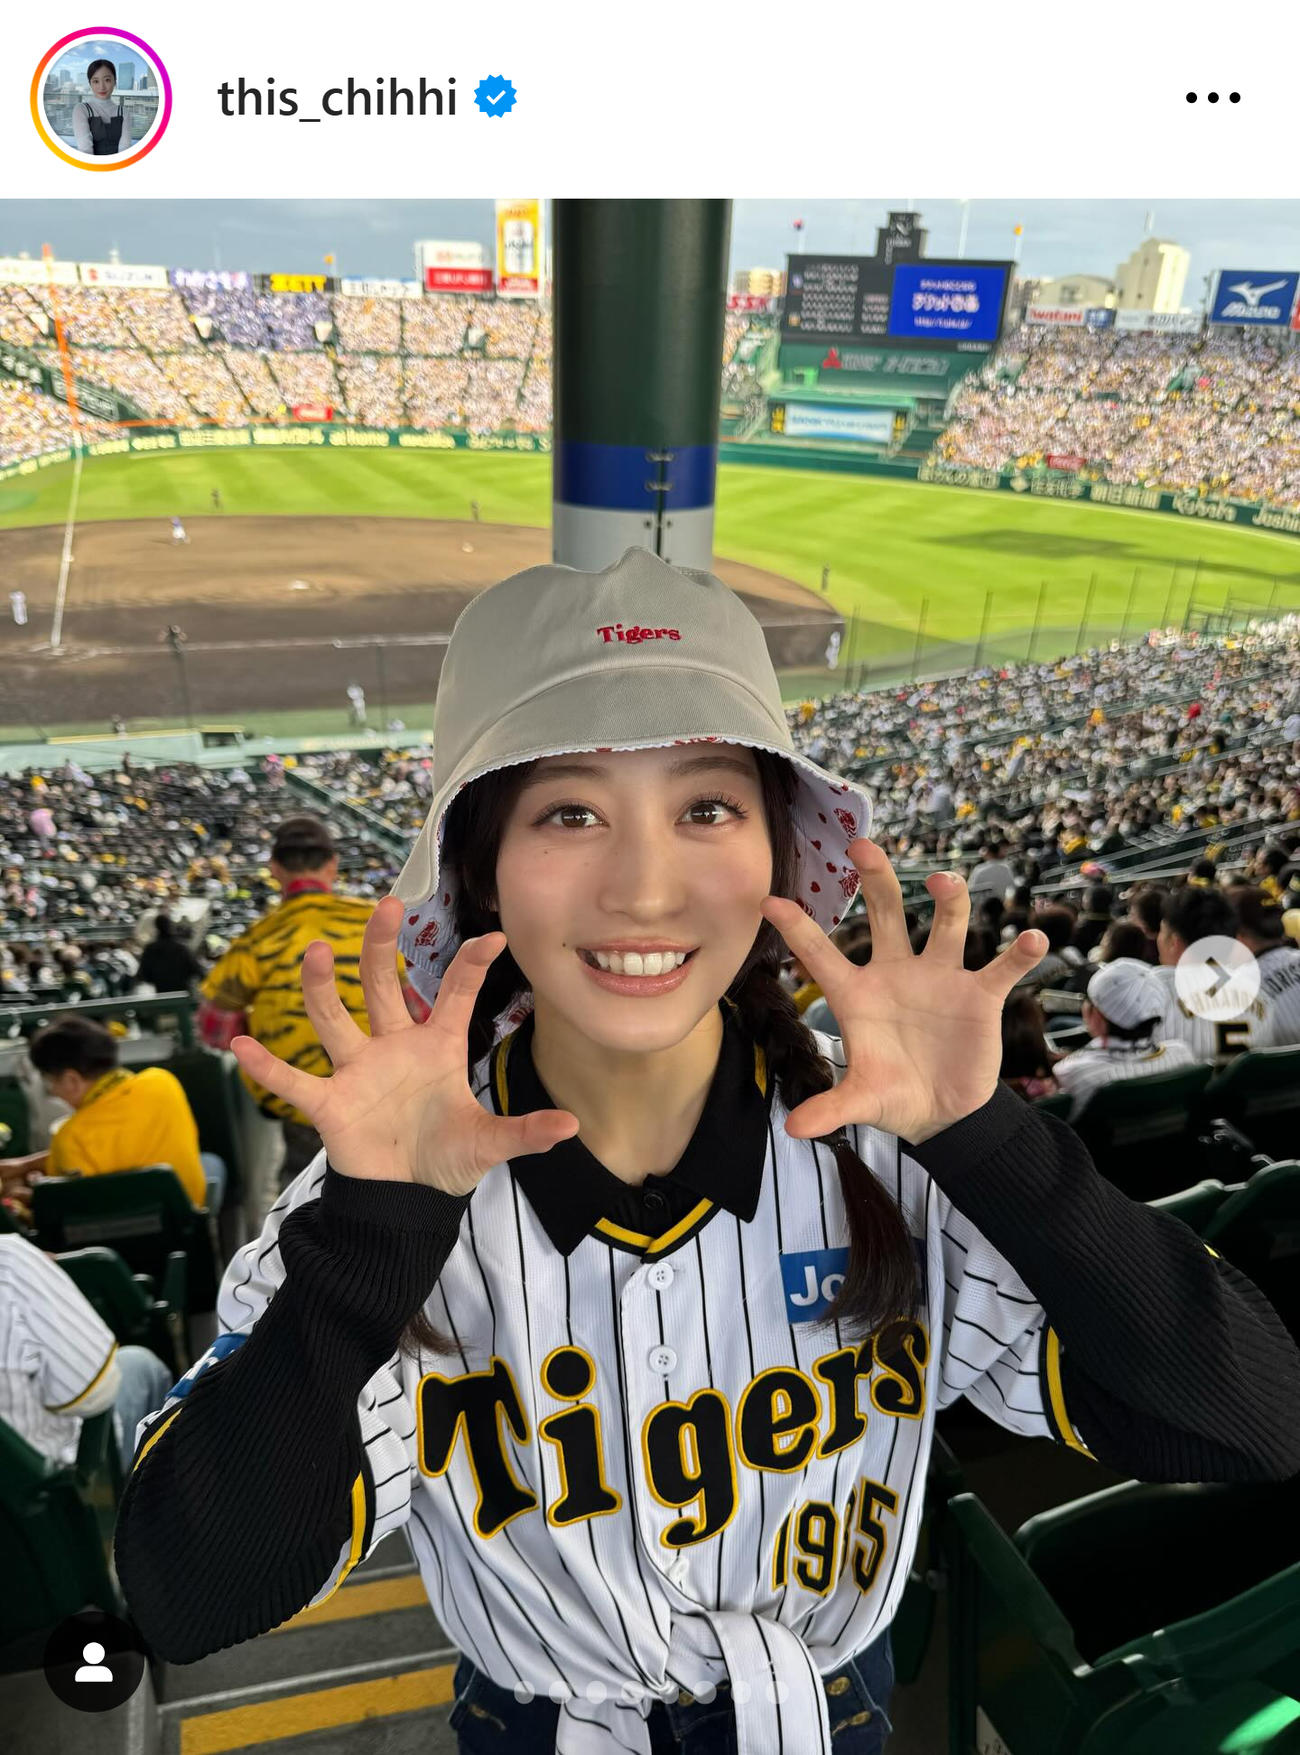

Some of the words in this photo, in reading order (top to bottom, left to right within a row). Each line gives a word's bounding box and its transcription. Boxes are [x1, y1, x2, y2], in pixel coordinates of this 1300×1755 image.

[596, 623, 682, 644] Tigers
[417, 1316, 929, 1549] Tigers
[772, 1476, 899, 1597] 195
